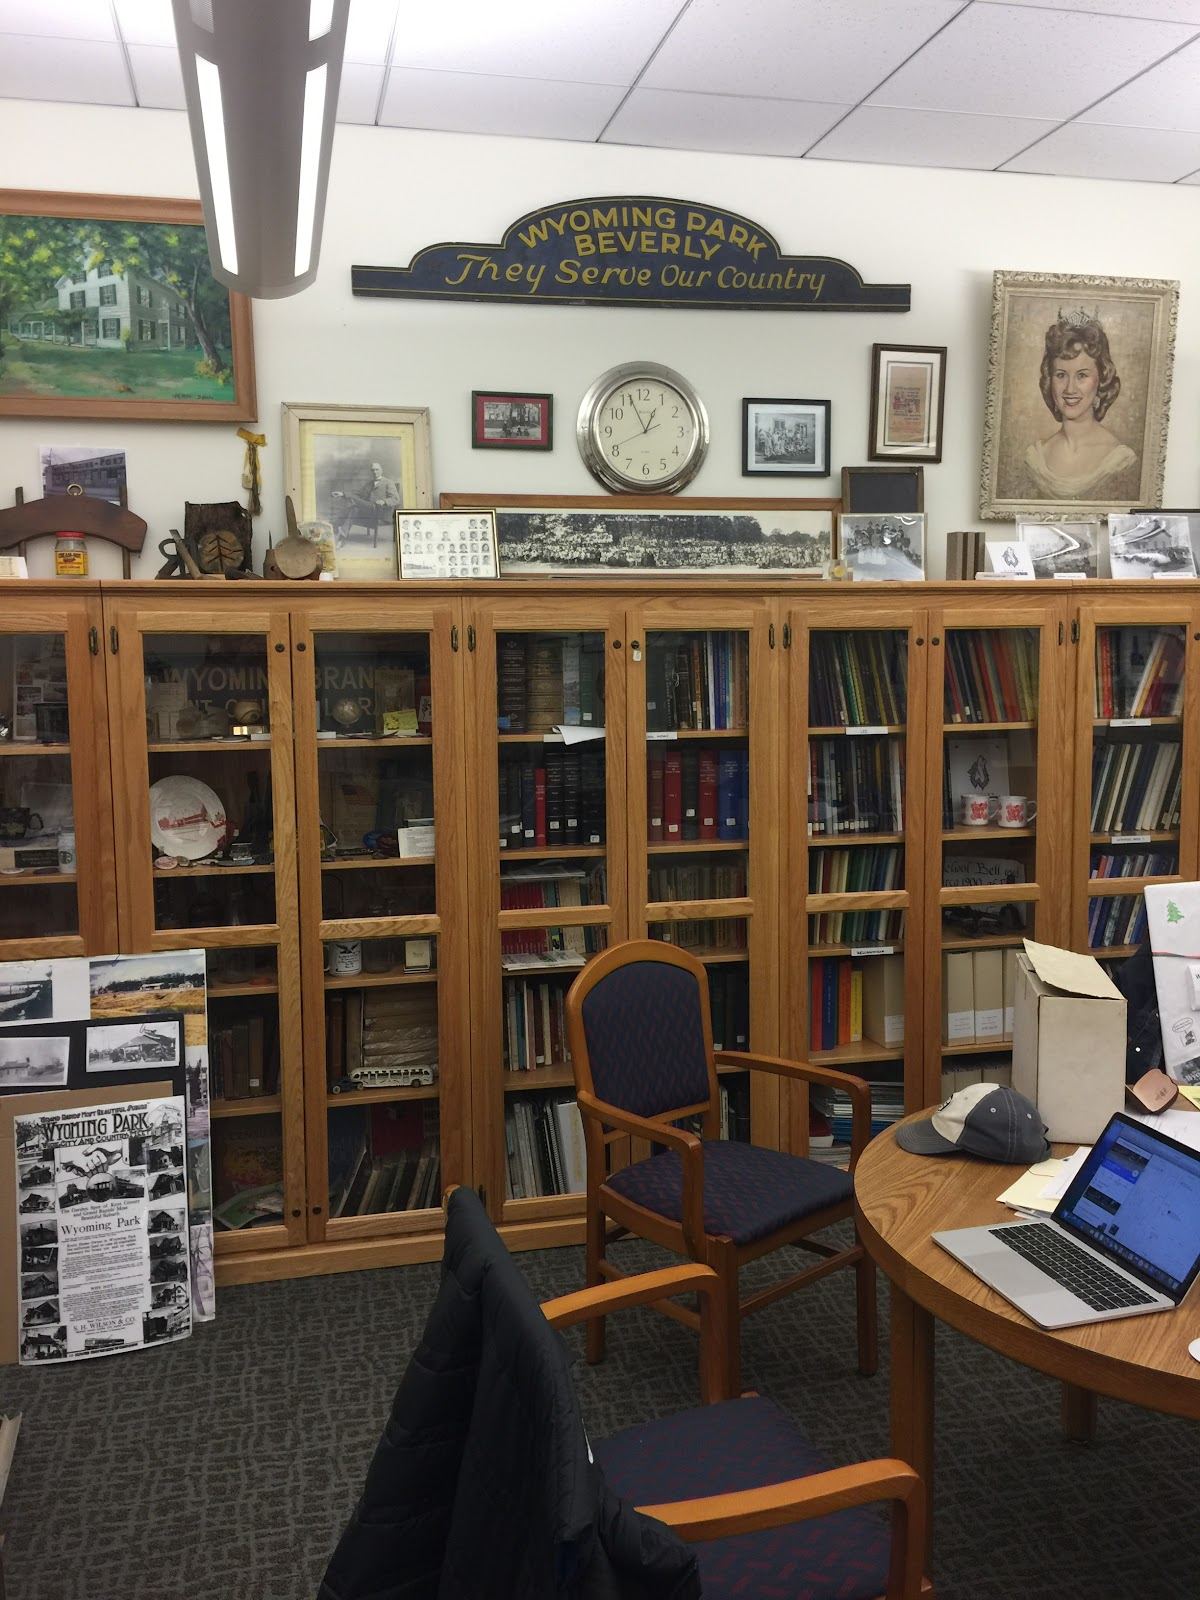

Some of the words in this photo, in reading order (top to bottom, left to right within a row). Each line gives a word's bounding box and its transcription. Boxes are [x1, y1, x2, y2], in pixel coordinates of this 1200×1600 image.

[518, 207, 676, 249] WYOMING
[687, 212, 767, 261] PARK
[574, 231, 722, 261] BEVERLY
[445, 253, 546, 294] They
[554, 259, 652, 286] Serve
[660, 264, 712, 288] Our
[717, 265, 826, 301] Country
[621, 394, 633, 407] 11
[636, 388, 651, 401] 12
[659, 393, 664, 406] 1
[610, 407, 624, 421] 10
[671, 406, 679, 418] 2
[604, 426, 613, 438] 9
[677, 426, 684, 439] 3
[612, 444, 620, 457] 8
[671, 445, 680, 457] 4
[625, 458, 633, 470] 7
[642, 463, 650, 475] 6
[660, 458, 667, 470] 5
[163, 666, 268, 691] WYOMIN
[43, 1118, 108, 1142] WYOMING
[112, 1112, 152, 1134] PARK
[61, 1221, 112, 1236] Wyoming
[117, 1215, 141, 1228] Park
